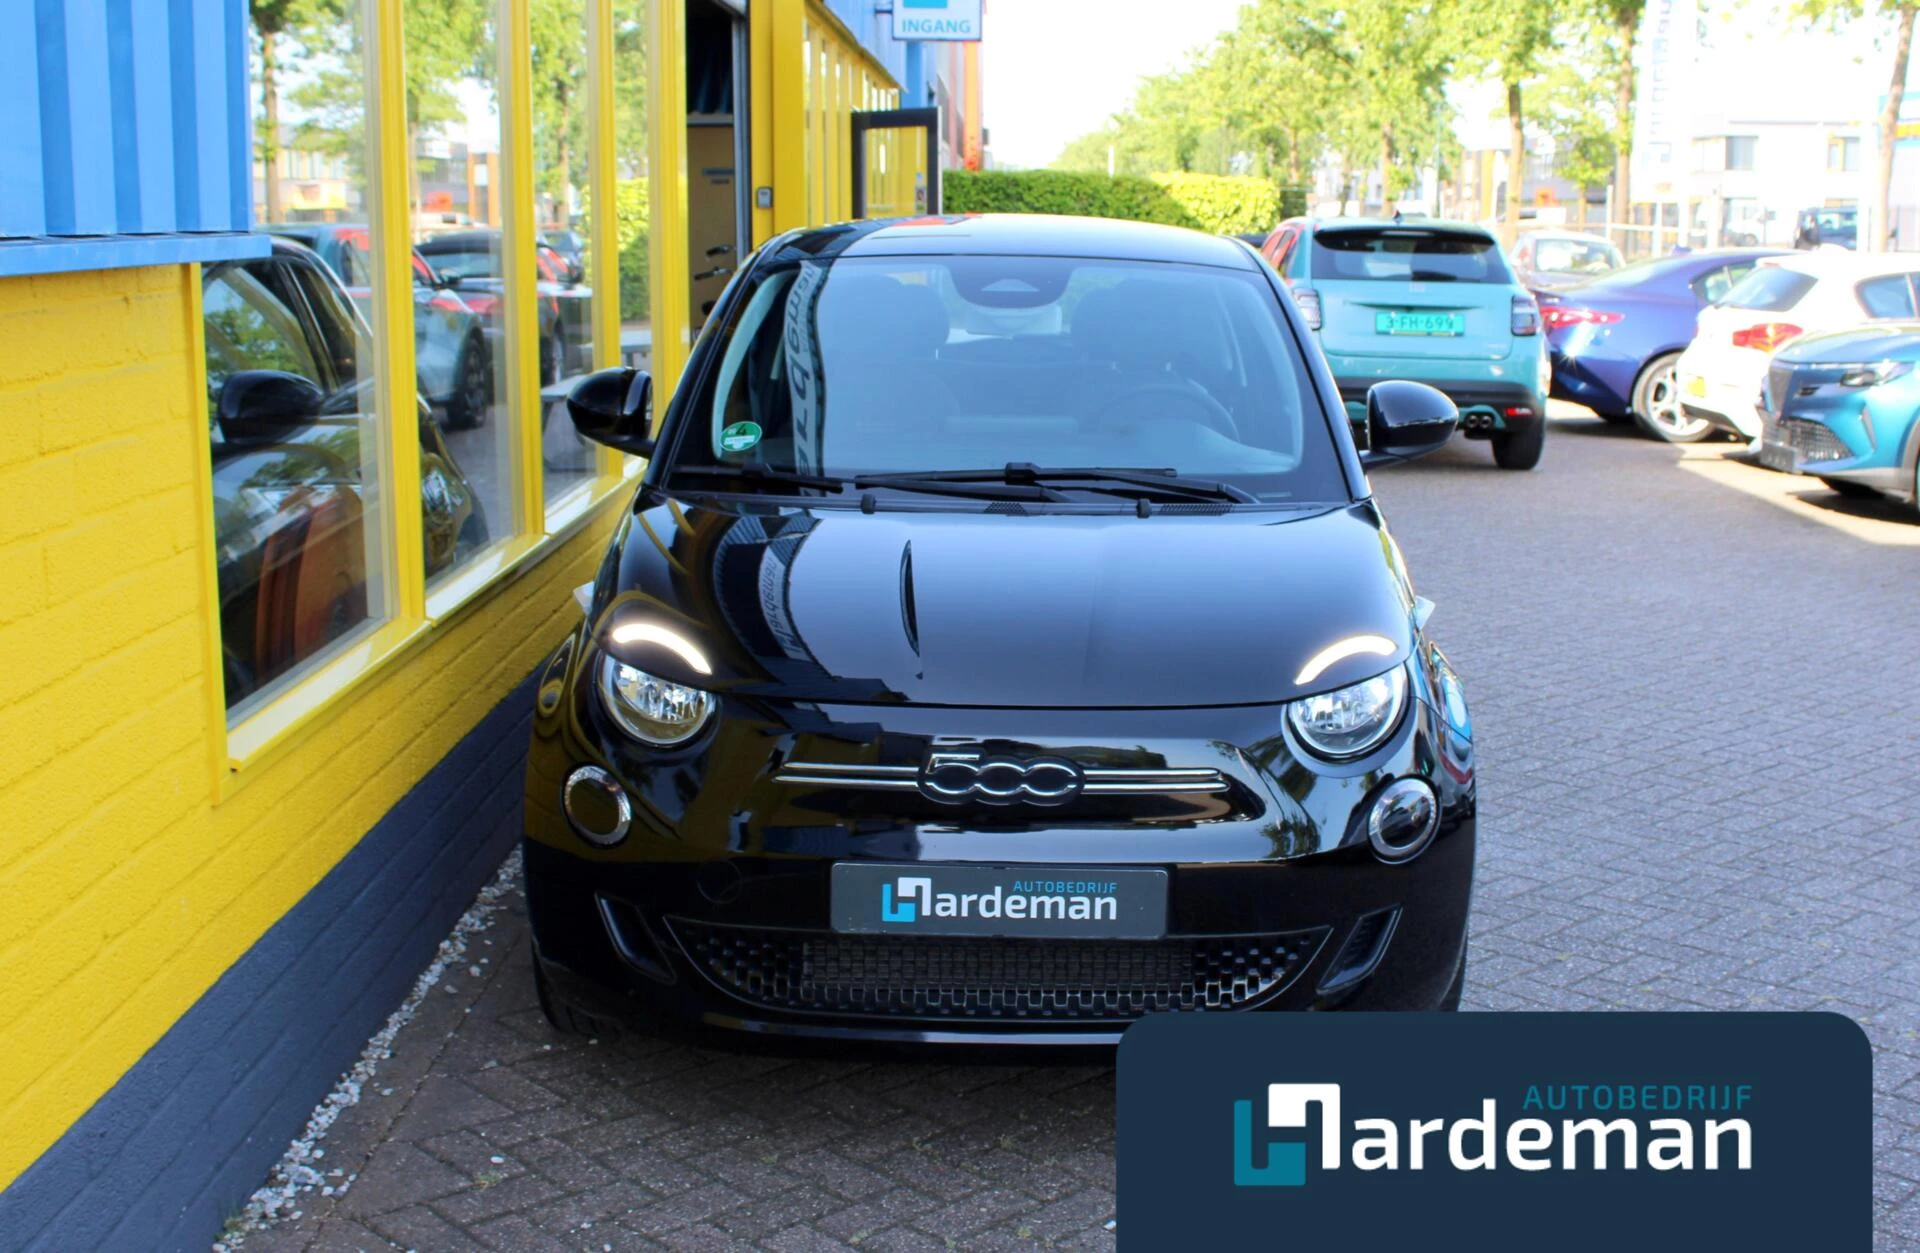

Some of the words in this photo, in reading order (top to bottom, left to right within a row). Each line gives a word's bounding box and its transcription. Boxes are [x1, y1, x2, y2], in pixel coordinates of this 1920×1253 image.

[902, 18, 971, 33] INGANG
[924, 753, 1077, 796] 500
[881, 877, 1117, 922] Hardeman
[1013, 880, 1118, 894] AUTOBEDRIJF
